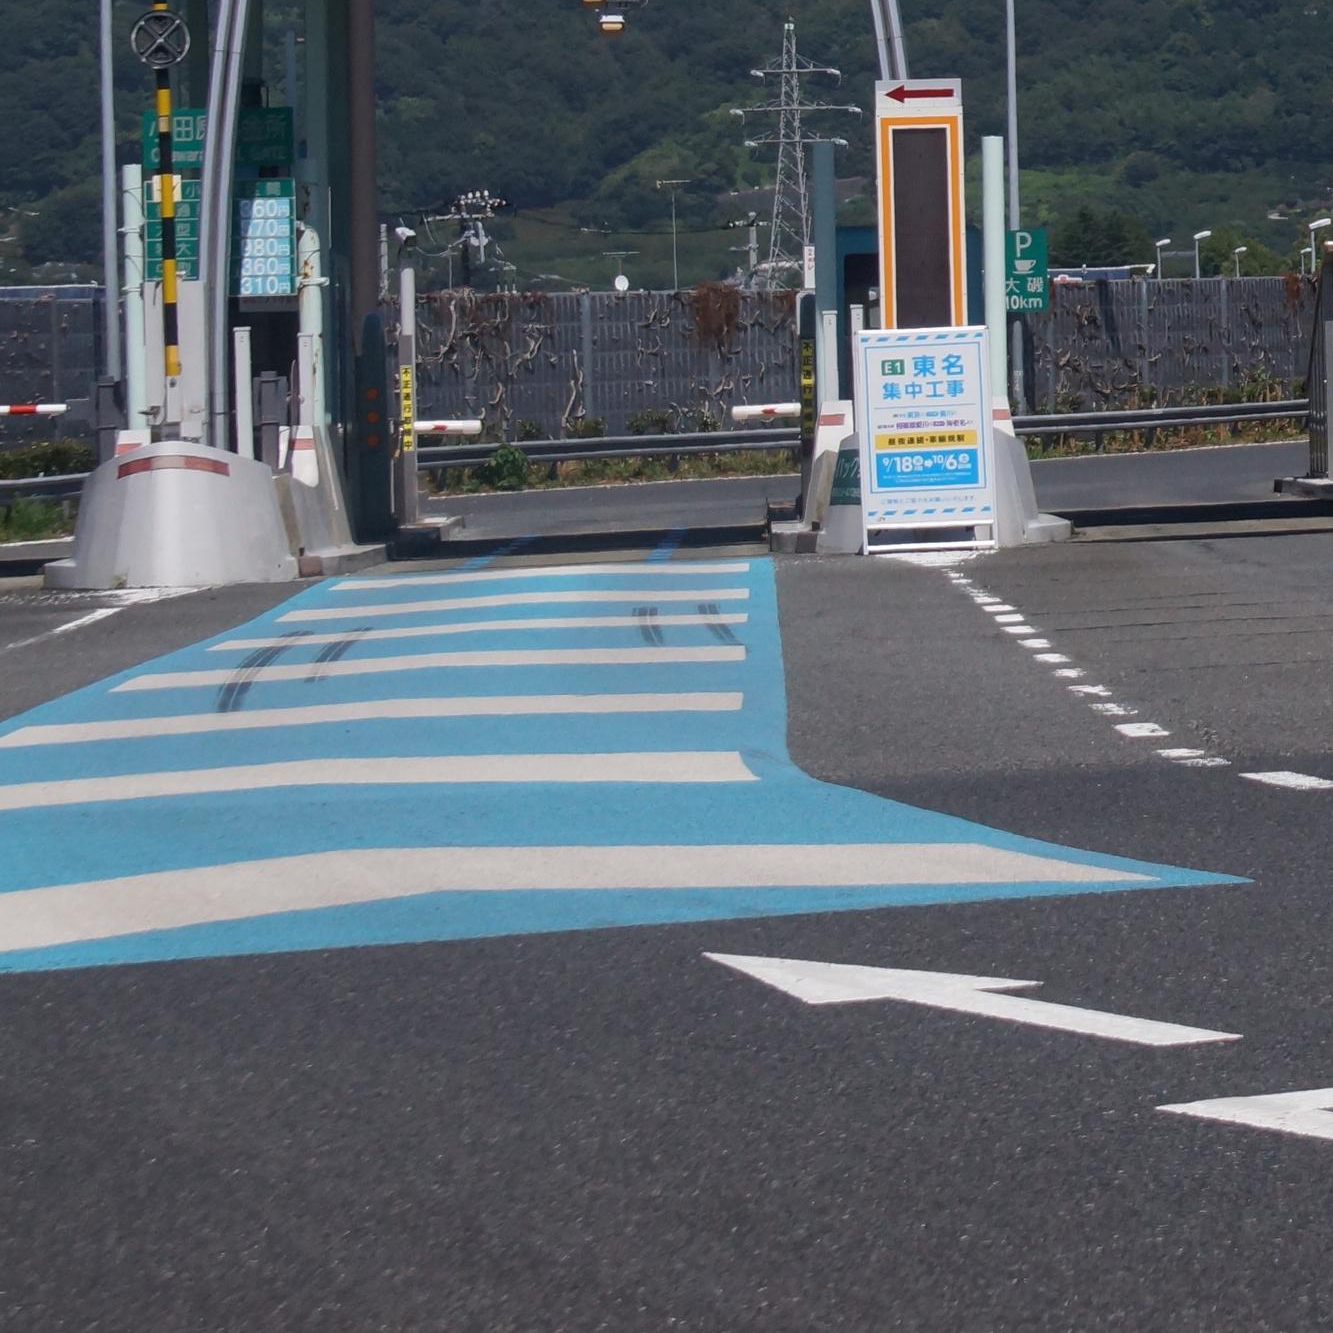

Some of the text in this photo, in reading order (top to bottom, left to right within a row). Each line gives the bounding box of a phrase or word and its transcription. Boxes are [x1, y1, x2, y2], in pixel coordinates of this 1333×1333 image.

[1016, 231, 1032, 257] P
[885, 354, 964, 378] E1 東名
[882, 379, 965, 400] 集中工事
